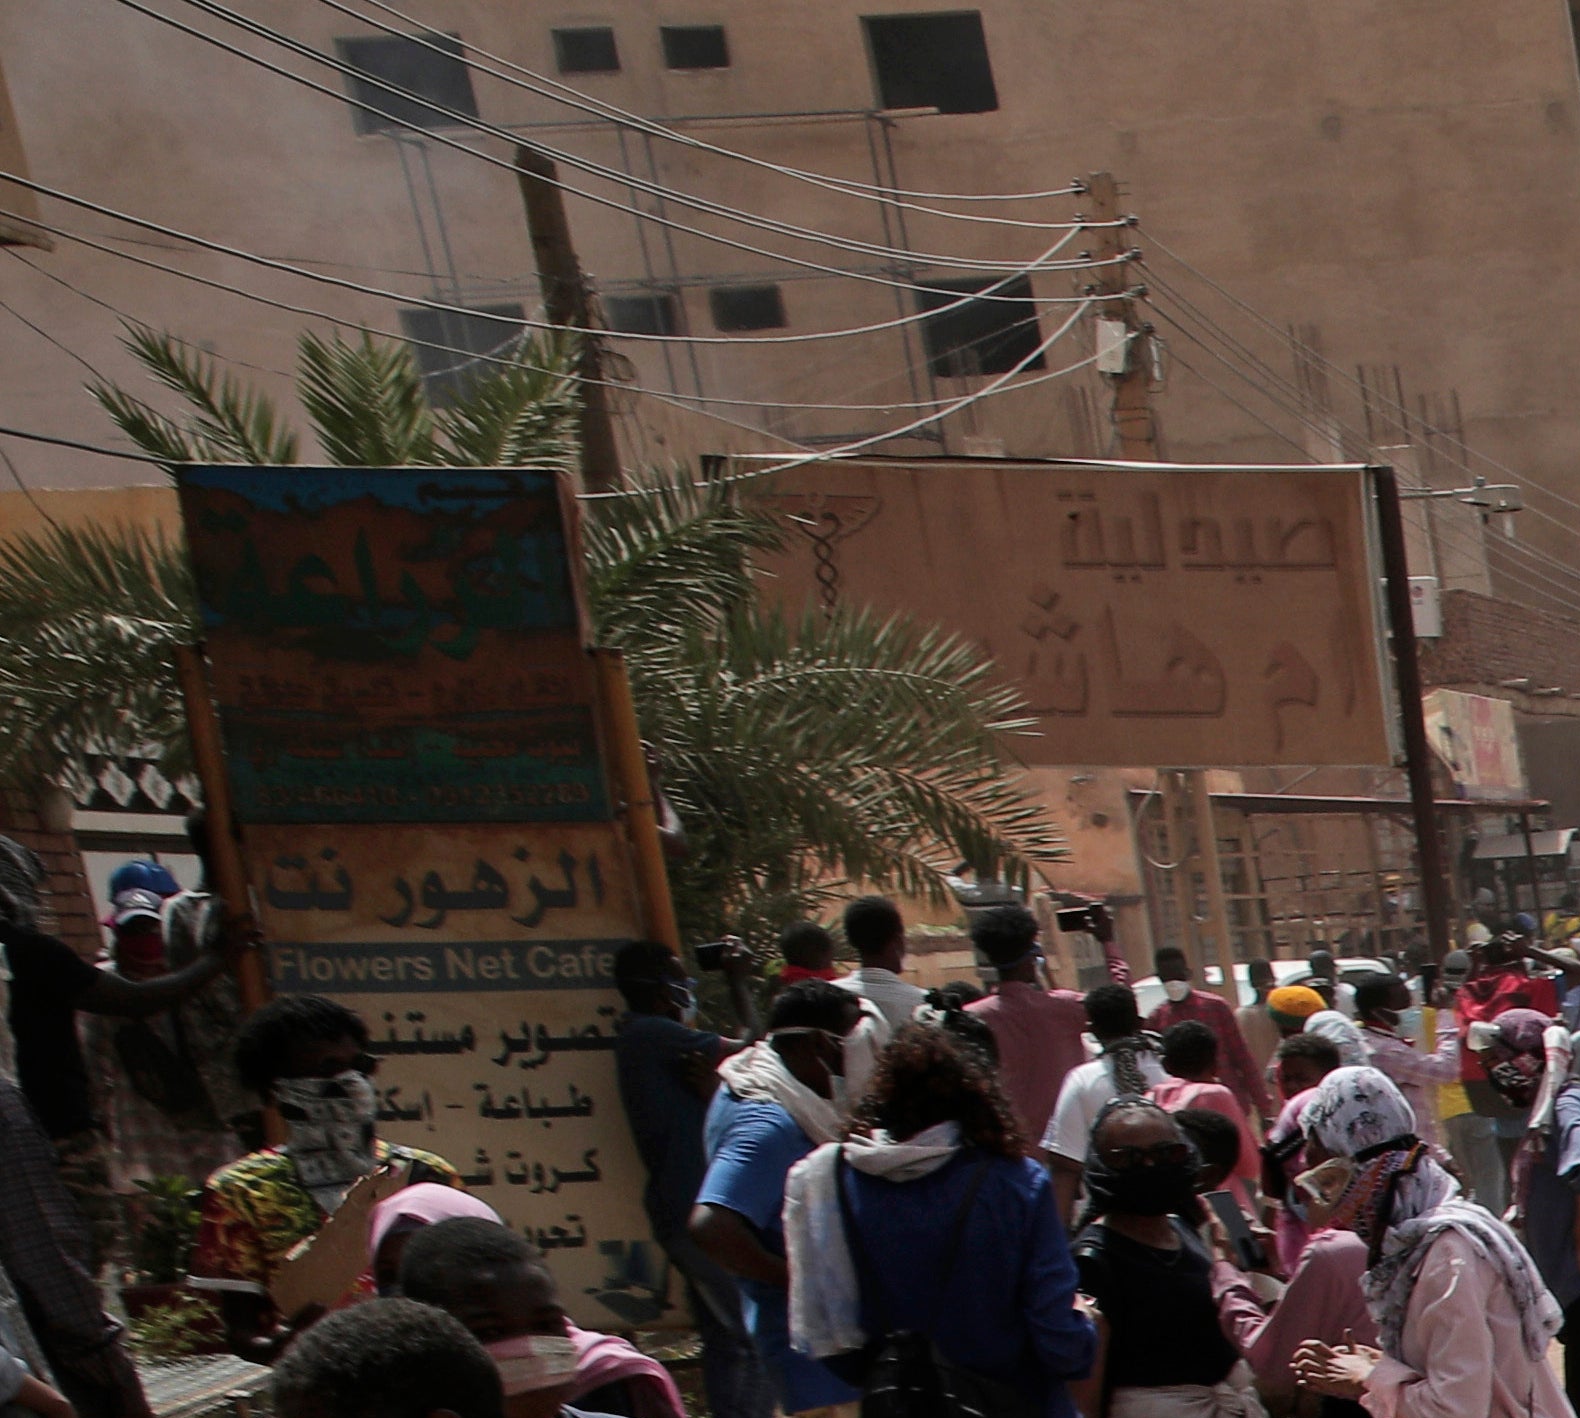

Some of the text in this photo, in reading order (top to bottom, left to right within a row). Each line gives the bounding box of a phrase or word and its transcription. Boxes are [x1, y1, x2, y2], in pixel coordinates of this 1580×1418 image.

[1054, 488, 1338, 586] صيدلية
[1000, 584, 1227, 719] هاش
[265, 846, 606, 929] الزهور نت
[271, 945, 616, 983] Flowers Net Cafe
[368, 1006, 622, 1070] تصوير مستن
[473, 1082, 595, 1130] طباعة
[505, 1147, 602, 1195] كروت
